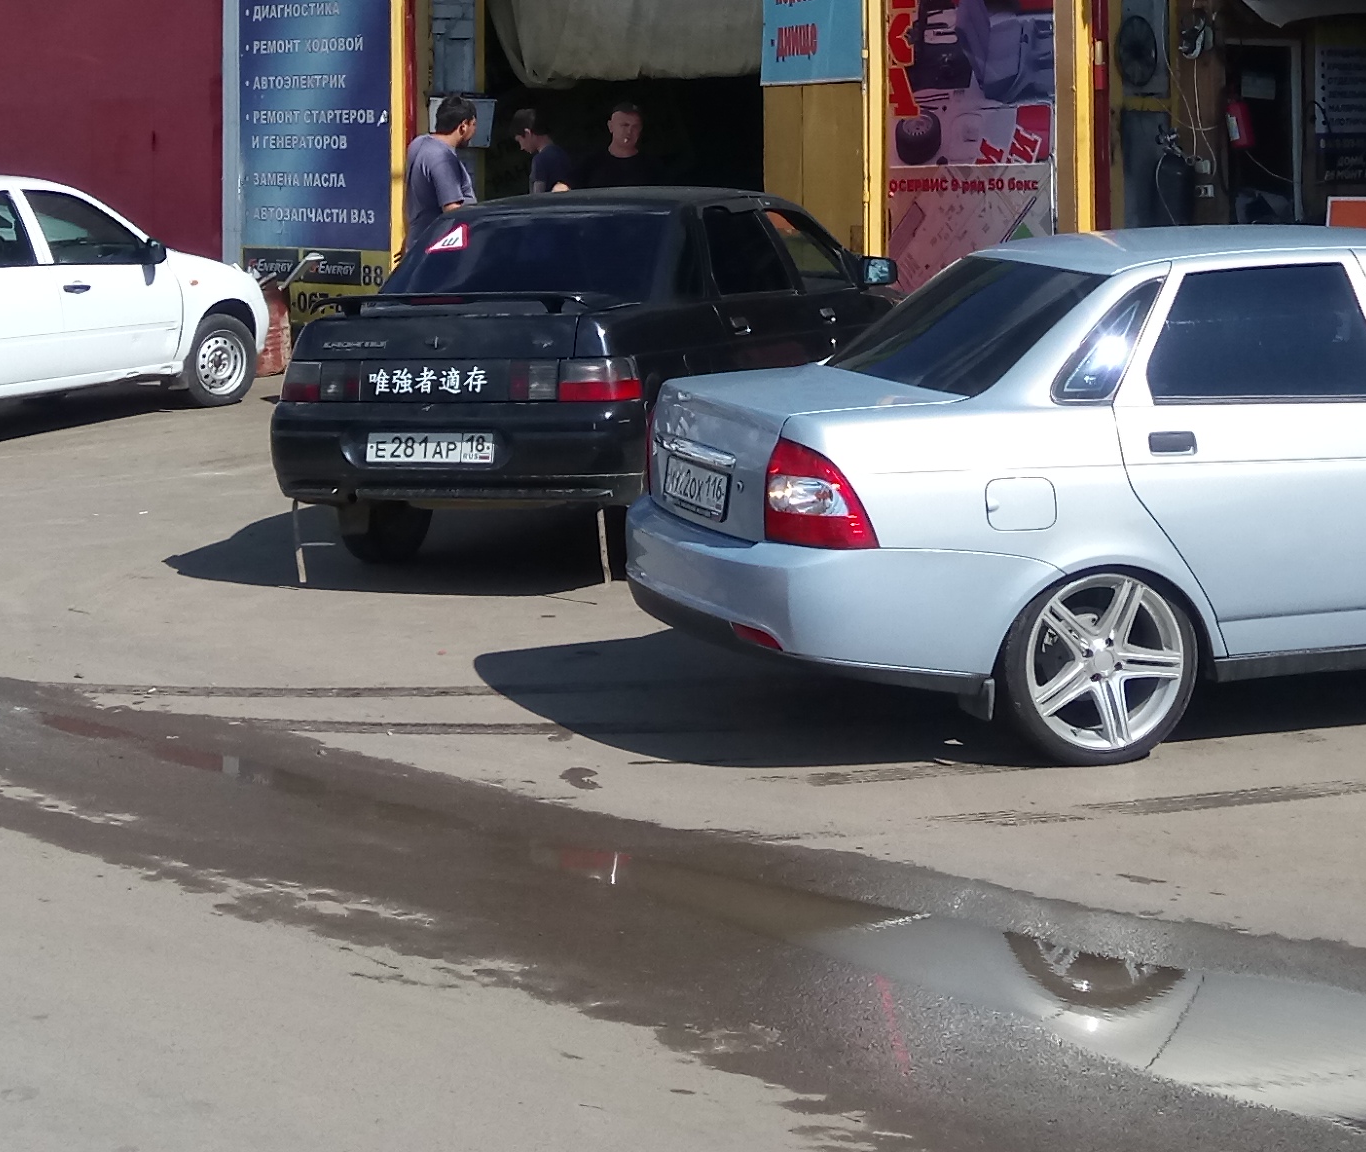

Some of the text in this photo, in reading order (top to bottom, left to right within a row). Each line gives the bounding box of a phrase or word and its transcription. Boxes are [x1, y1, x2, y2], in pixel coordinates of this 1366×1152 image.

[252, 1, 340, 21] ДИАГНОСТИКА
[252, 34, 364, 54] РЕМОНТ ХОДОВОЙ
[252, 74, 346, 91] АВТОЭЛЕКТРИК
[252, 109, 375, 124] РЕМОНТ СТАРТЕРОВ
[251, 135, 348, 149] И ГЕНЕРАТОРОВ
[253, 173, 346, 188] ЗАМЕНА МАСЛА
[988, 178, 1004, 191] 50
[1008, 177, 1038, 191] бокс
[253, 208, 375, 225] АВТОЗАПЧАСТИ ВАЗ
[442, 236, 459, 247] Ш
[369, 366, 488, 395] 唯強者適存
[375, 435, 486, 459] Е281АР 18
